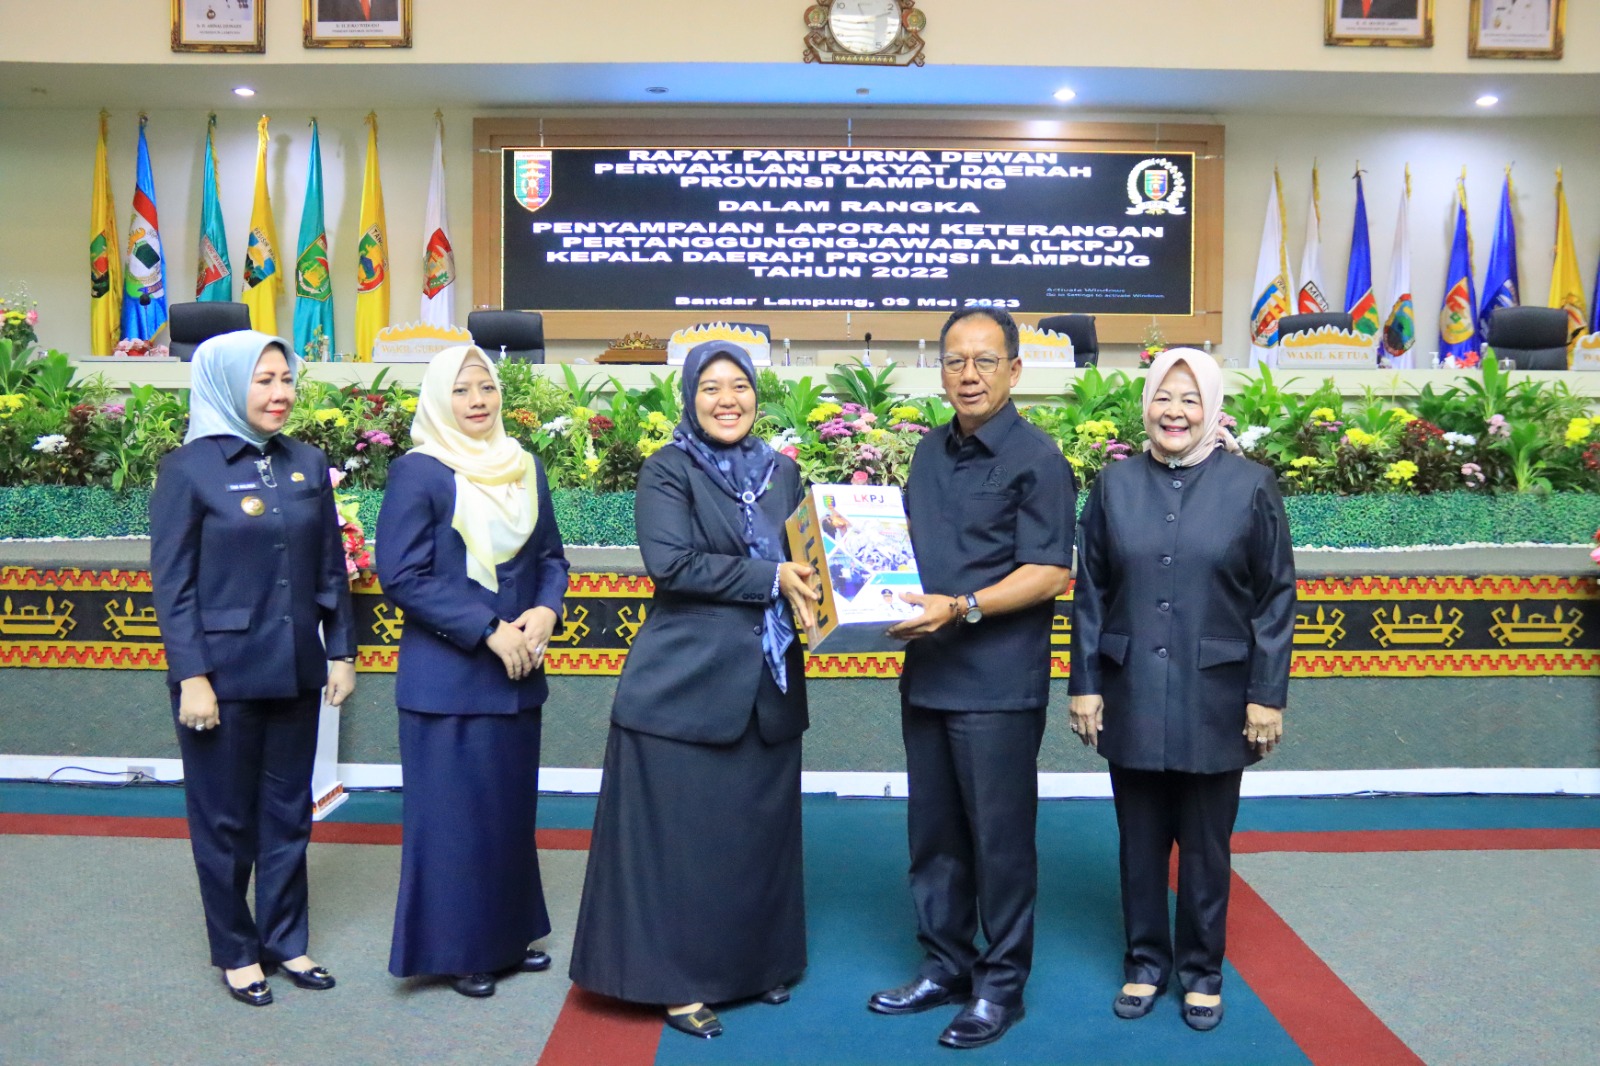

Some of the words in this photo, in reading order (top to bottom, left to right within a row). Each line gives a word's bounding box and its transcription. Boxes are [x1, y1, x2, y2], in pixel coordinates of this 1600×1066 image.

[629, 150, 733, 162] RAPAT
[743, 150, 932, 163] PARIPURNA
[941, 151, 1058, 164] DEWAN
[595, 163, 810, 175] PERWAKILAN
[821, 164, 951, 176] RAKYAT
[960, 165, 1092, 178] DAERAH
[680, 176, 834, 188] PROVINSI
[846, 177, 1007, 190] LAMPUNG
[719, 201, 830, 212] DALAM
[841, 201, 981, 213] RANGKA
[533, 222, 765, 234] PENYAMPAIAN
[776, 223, 930, 235] LAPORAN
[941, 224, 1164, 238] KETERANGAN
[563, 237, 1020, 251] PERTANGGUNGNGJAWABAN
[1030, 240, 1135, 254] (LKPJ)
[547, 251, 673, 263] KEPALA
[683, 251, 815, 264] DAERAH
[826, 252, 980, 265] PROVINSI
[991, 253, 1151, 266] LAMPUNG
[748, 266, 862, 278] TAHUN
[872, 266, 949, 279] 2022
[675, 296, 757, 306] Bandar
[763, 297, 875, 309] Lampung,
[882, 297, 911, 307] 09
[917, 297, 957, 307] Mei
[964, 298, 1021, 309] 2023
[1286, 351, 1323, 360] WAKIL
[1328, 351, 1369, 360] KETUA
[853, 494, 884, 503] LKPJ
